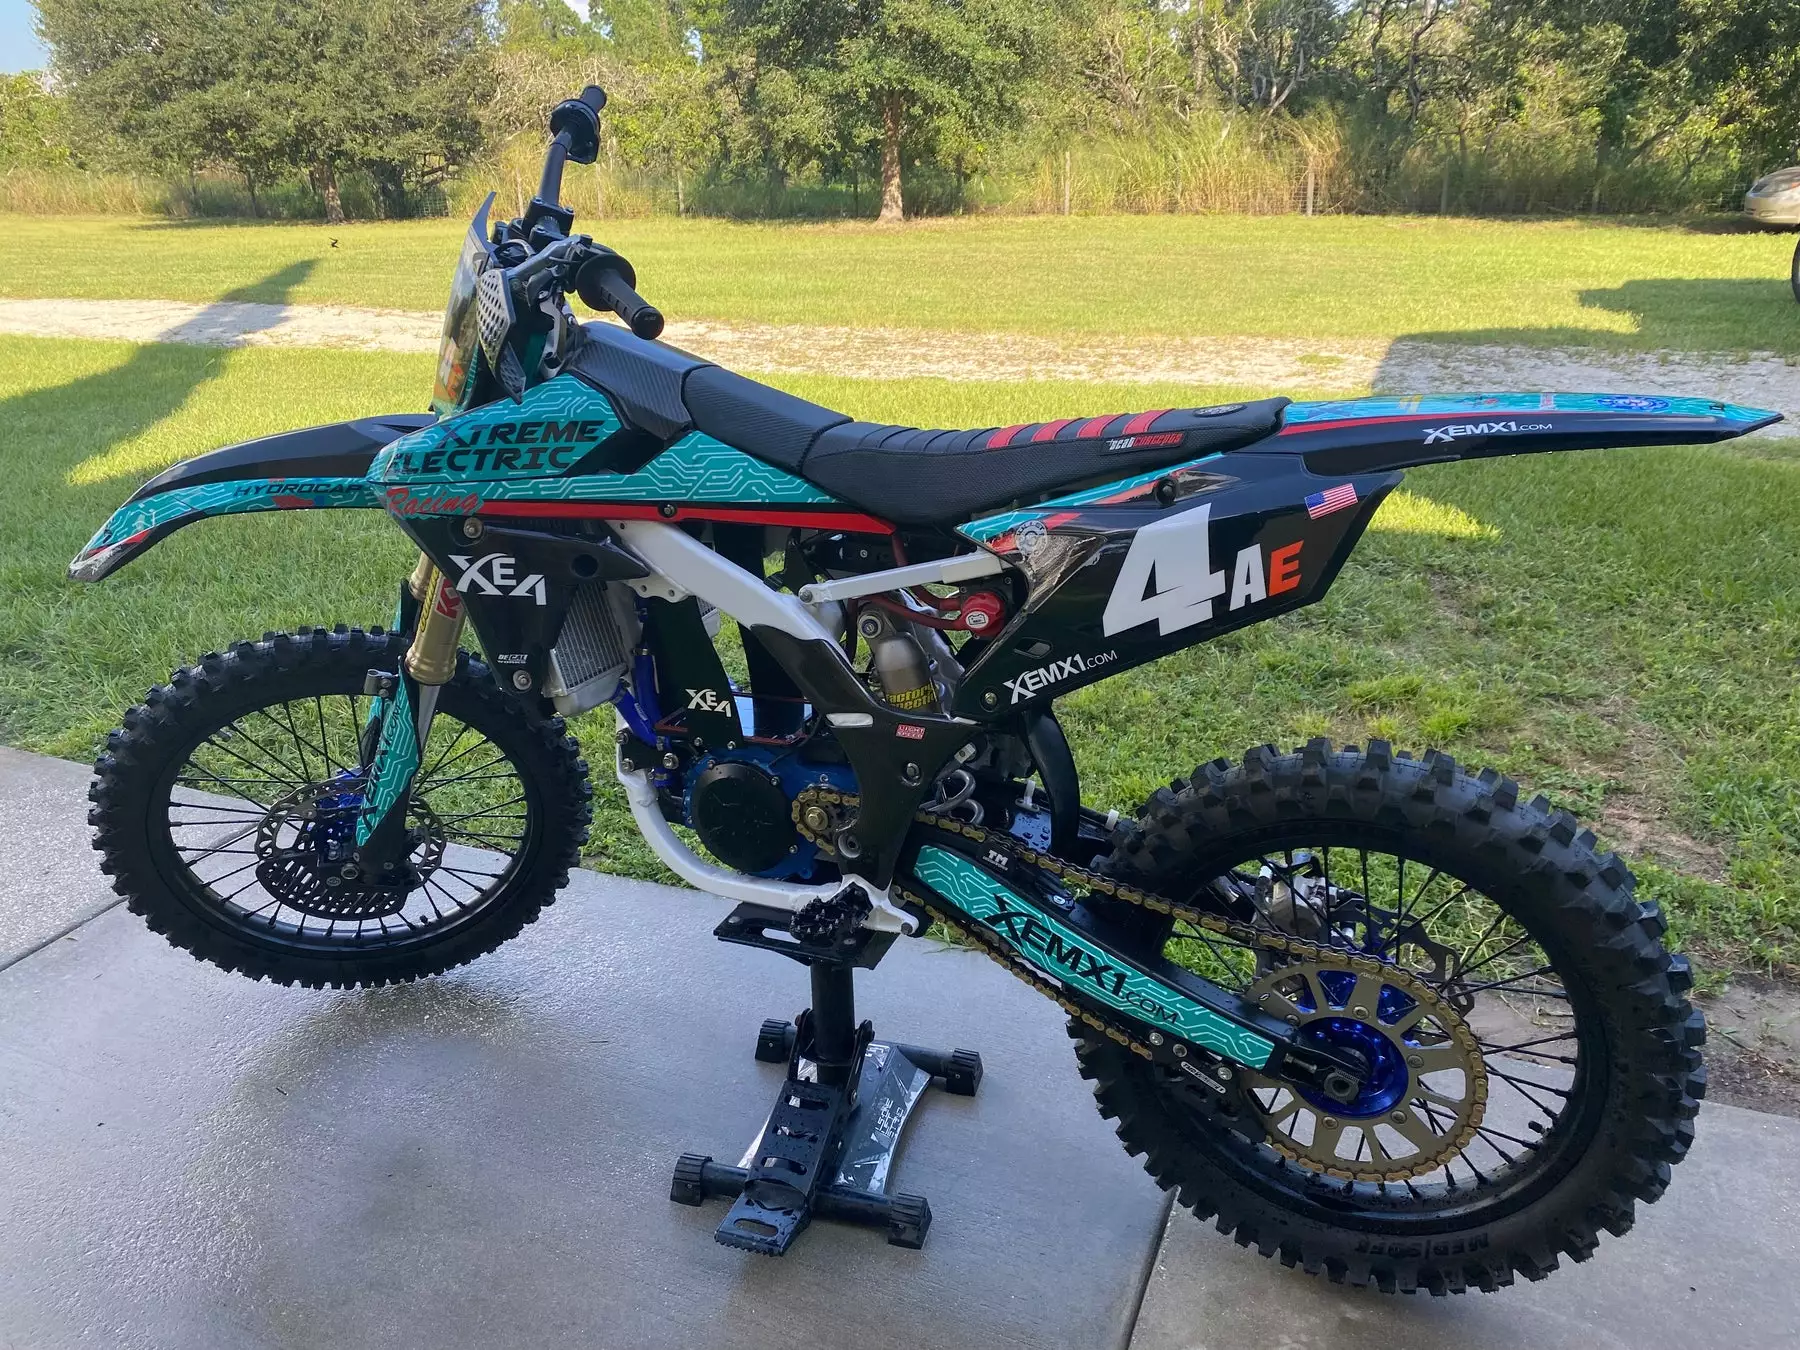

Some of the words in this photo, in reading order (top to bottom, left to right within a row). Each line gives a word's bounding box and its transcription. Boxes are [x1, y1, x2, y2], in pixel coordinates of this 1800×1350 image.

[386, 487, 480, 516] Racing
[1003, 650, 1117, 705] XEMX1.COM
[982, 892, 1178, 1024] XEMX1.COM
